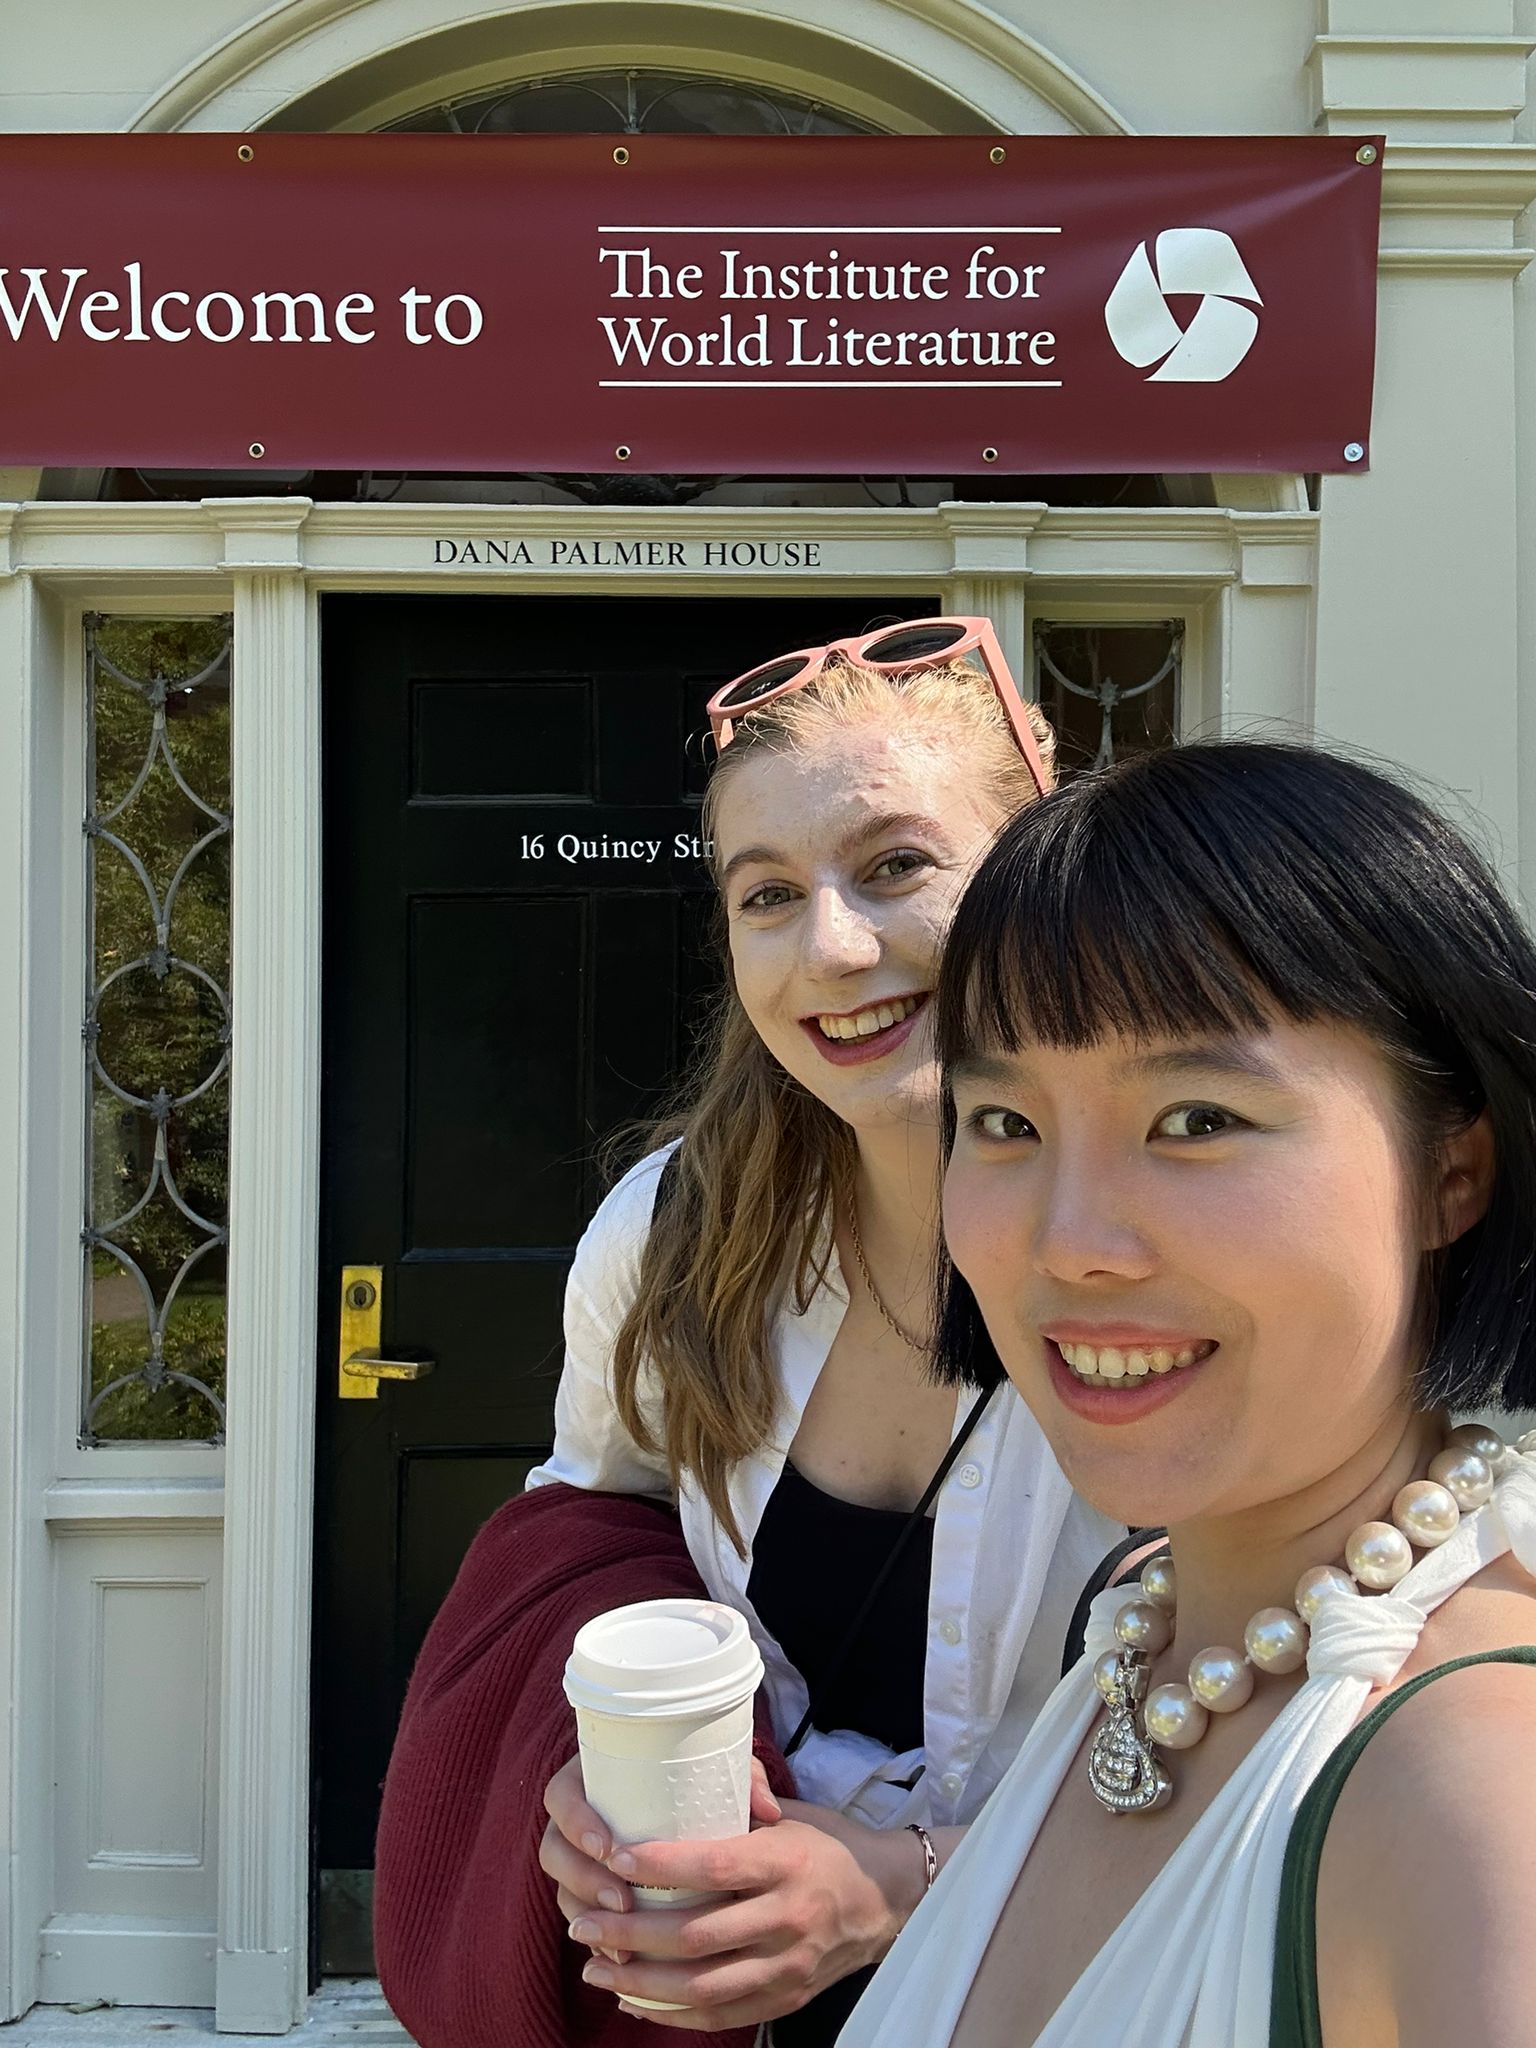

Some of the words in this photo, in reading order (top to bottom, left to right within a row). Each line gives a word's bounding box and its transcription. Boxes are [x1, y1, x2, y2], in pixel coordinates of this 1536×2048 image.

[599, 248, 703, 299] The
[720, 250, 949, 300] Institute
[965, 246, 1046, 299] for
[0, 262, 376, 344] Welcome
[400, 287, 484, 345] to
[598, 314, 773, 367] World
[786, 318, 1056, 366] Literature
[434, 540, 534, 564] DANA
[551, 541, 687, 566] PALMER
[704, 542, 822, 567] HOUSE
[521, 834, 545, 860] 16
[557, 833, 662, 864] Quincy
